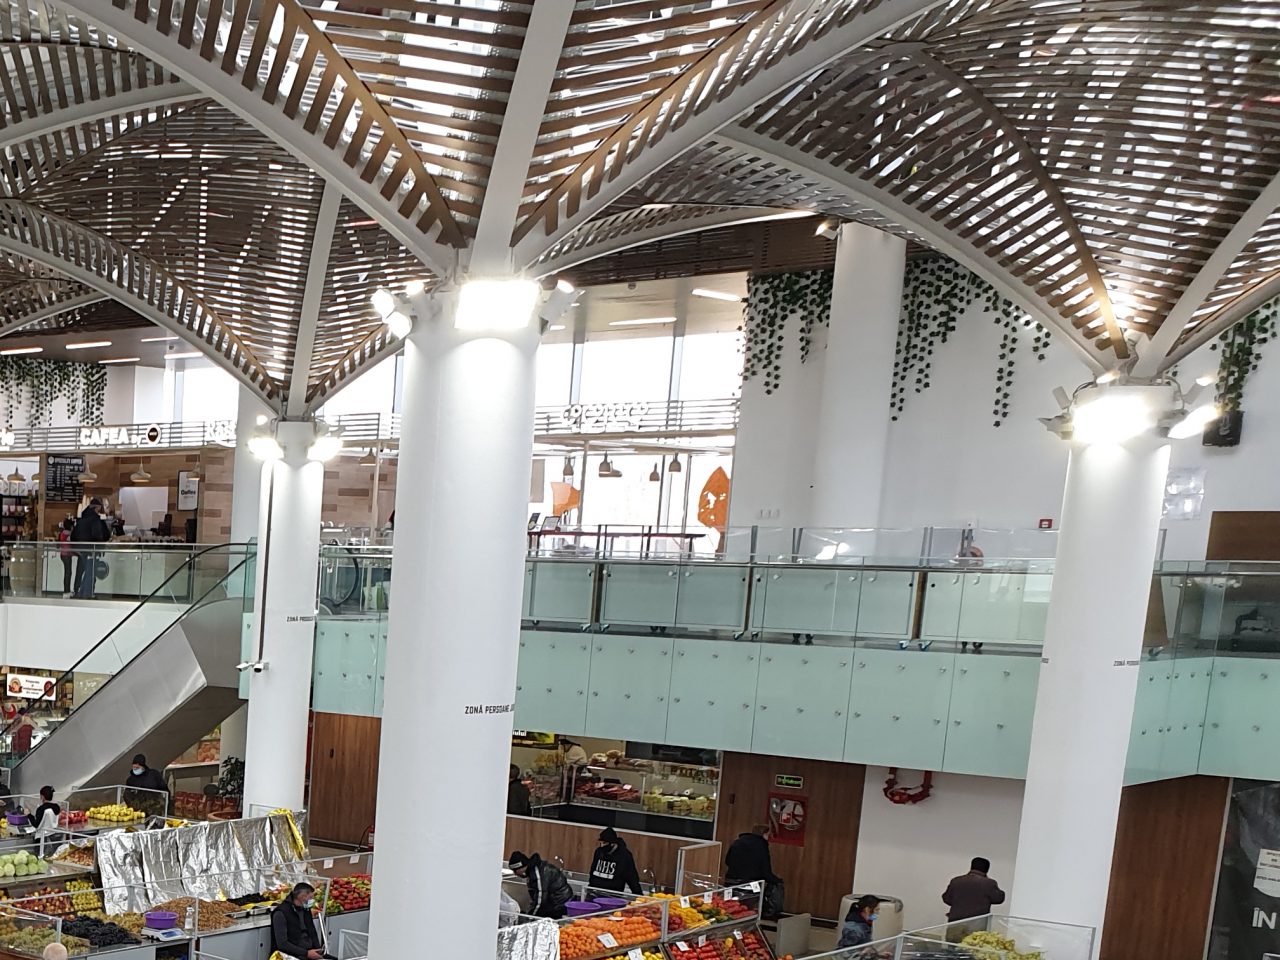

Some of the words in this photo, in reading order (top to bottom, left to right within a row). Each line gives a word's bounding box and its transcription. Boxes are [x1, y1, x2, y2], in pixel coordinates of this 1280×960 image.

[80, 427, 129, 445] CAFEA
[465, 704, 483, 714] ZONĂ
[596, 859, 616, 875] NHS
